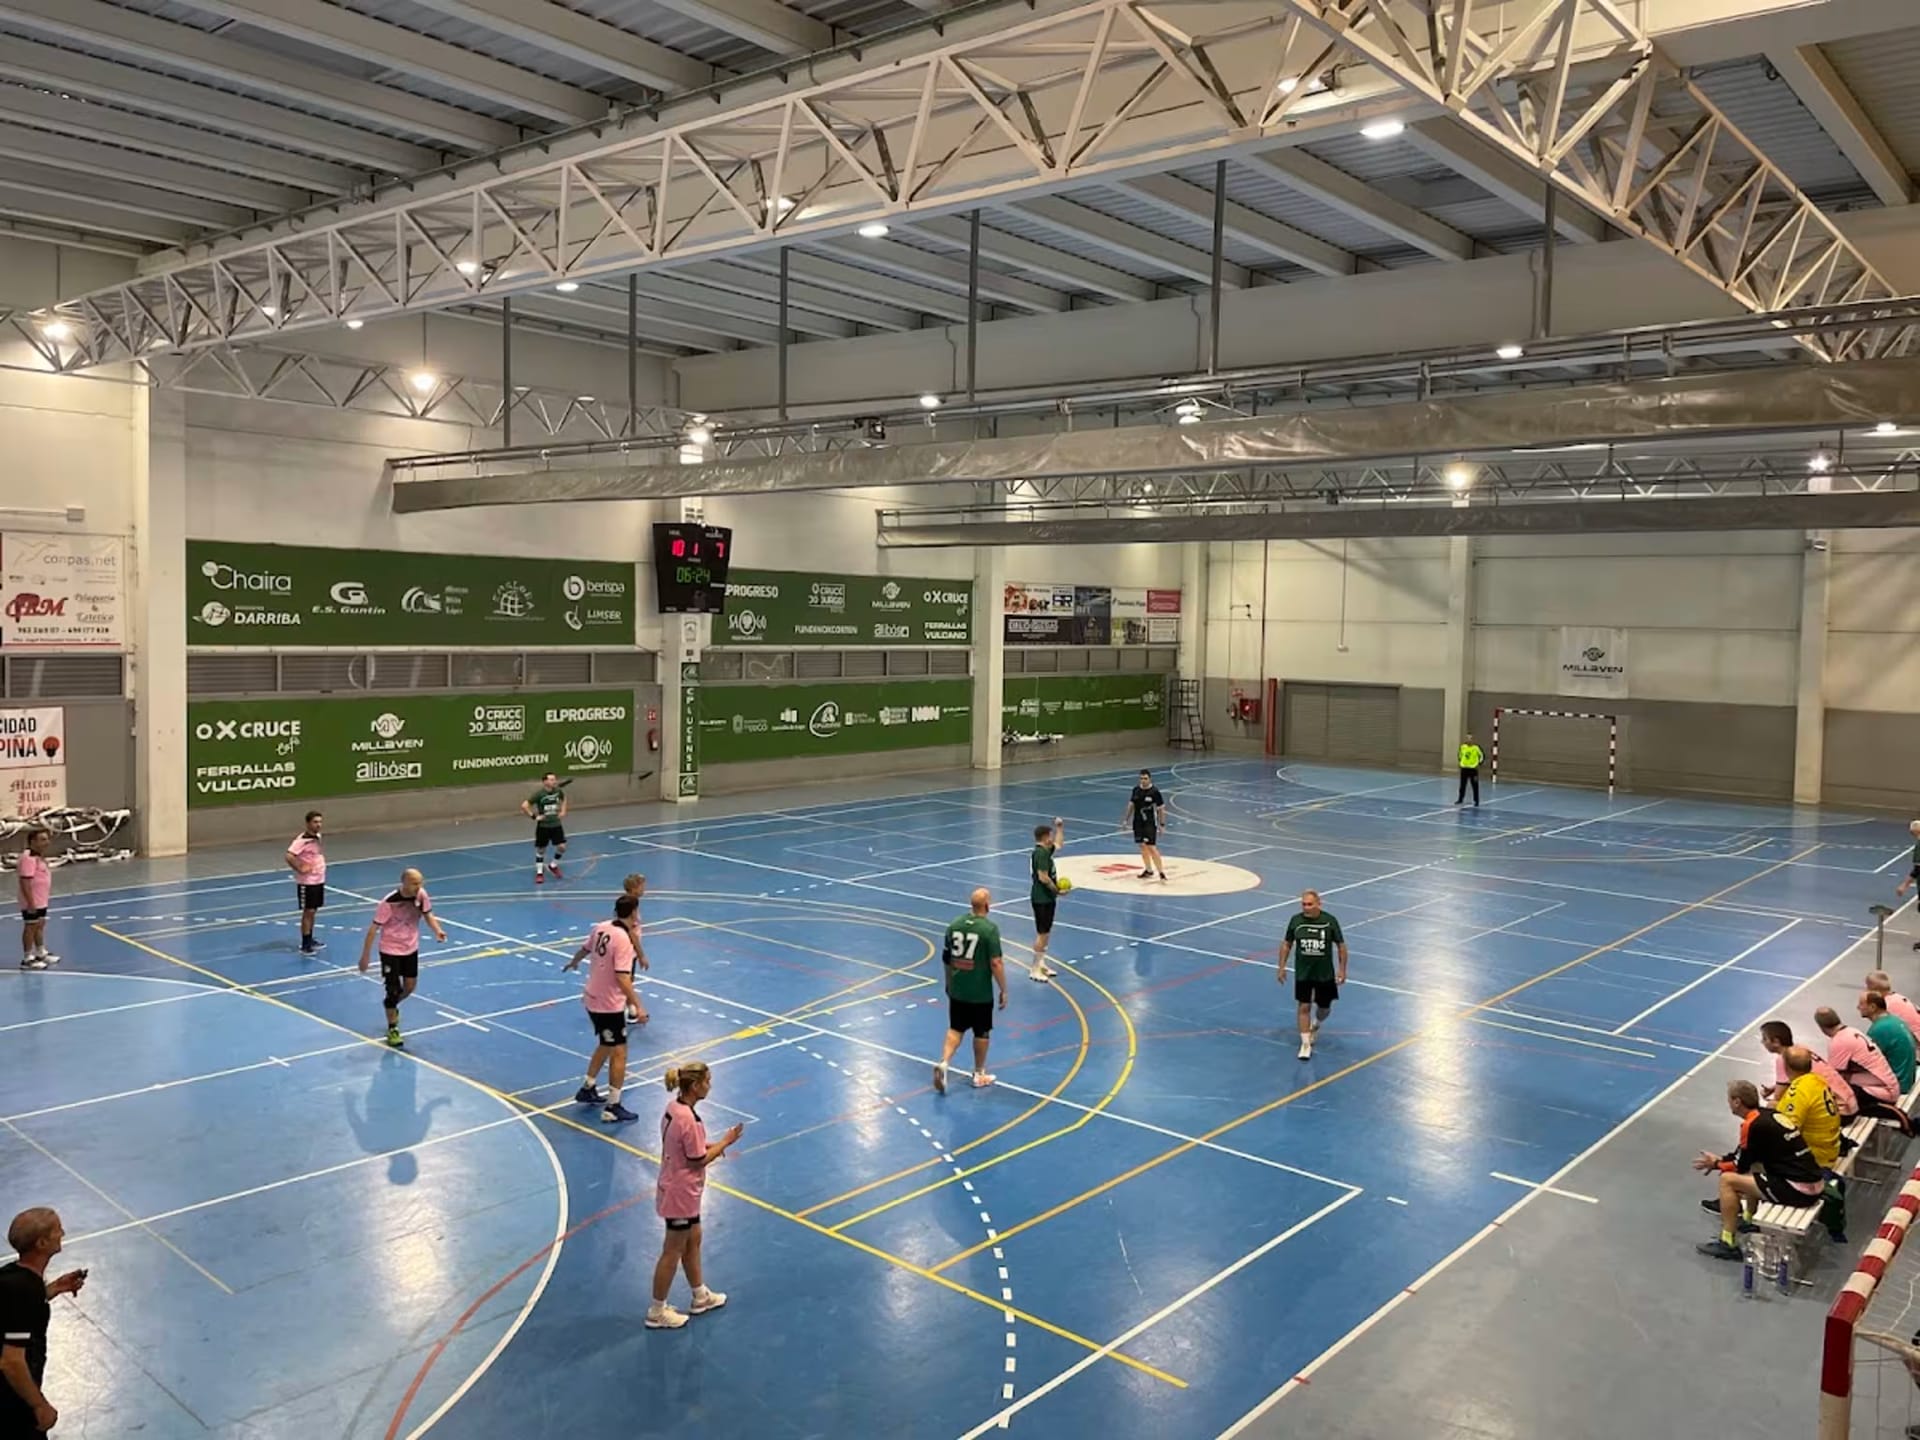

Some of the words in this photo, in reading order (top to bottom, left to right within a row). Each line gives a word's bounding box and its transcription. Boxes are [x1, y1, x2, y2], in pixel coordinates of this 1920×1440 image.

[208, 563, 292, 590] Chaira
[724, 584, 779, 598] PROGRESO
[234, 612, 301, 625] DARRIBA
[196, 761, 296, 777] FERRALLAS
[453, 753, 549, 770] FUNDINOXCORTEN
[196, 775, 296, 793] VULCANO
[595, 931, 611, 957] 18
[951, 931, 978, 960] 37
